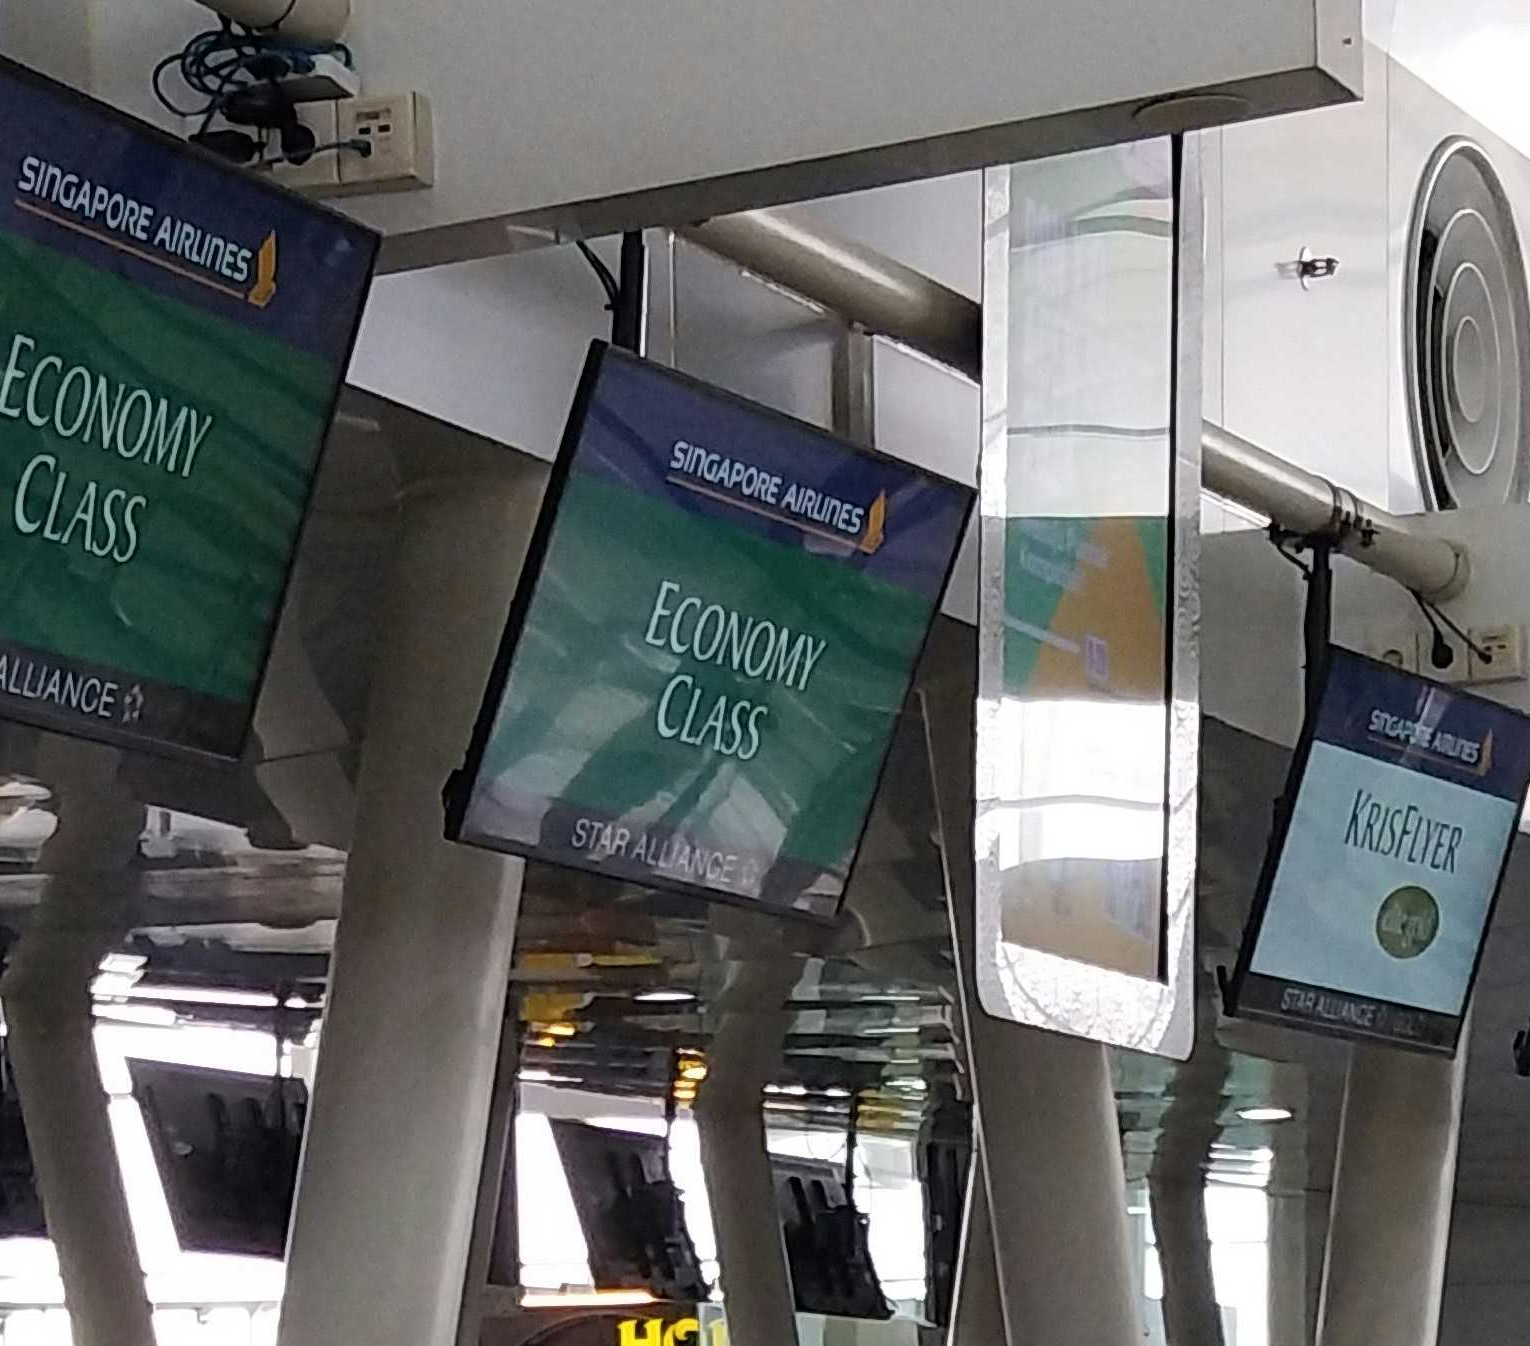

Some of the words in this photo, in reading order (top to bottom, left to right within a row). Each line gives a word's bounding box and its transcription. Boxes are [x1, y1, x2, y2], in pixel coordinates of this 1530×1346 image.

[18, 156, 154, 241] SINGAPORE
[153, 215, 254, 283] AIRLINES
[14, 453, 148, 563] CLASS
[669, 440, 783, 505] SINGAPORE
[780, 482, 865, 535] AIRLINES
[645, 580, 827, 691] ECONOMY
[657, 674, 769, 761] CLASS
[571, 817, 631, 858] STAR
[629, 832, 739, 883] ALLIANCE
